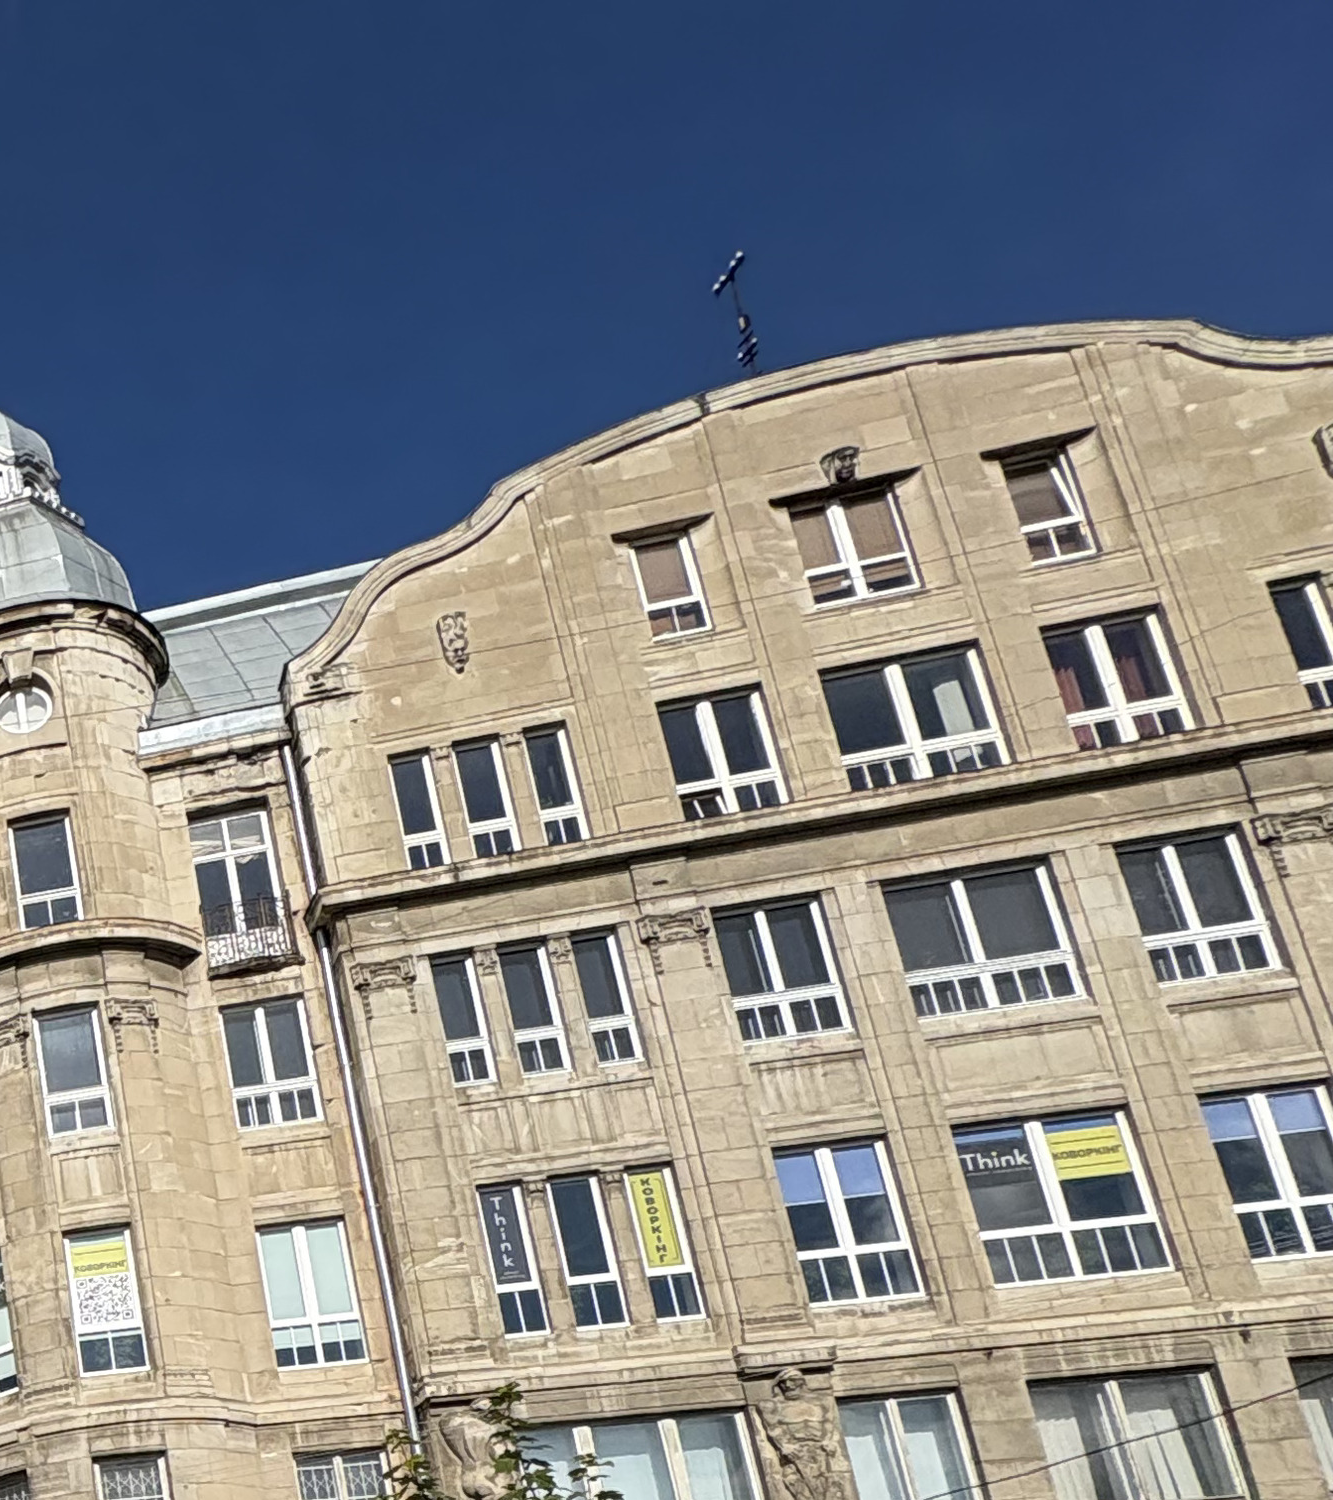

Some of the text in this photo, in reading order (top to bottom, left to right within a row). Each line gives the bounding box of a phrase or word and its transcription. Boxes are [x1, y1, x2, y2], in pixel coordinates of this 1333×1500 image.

[958, 1149, 1031, 1172] Think
[489, 1196, 515, 1268] Think
[639, 1177, 668, 1264] КОВОРКІНГ
